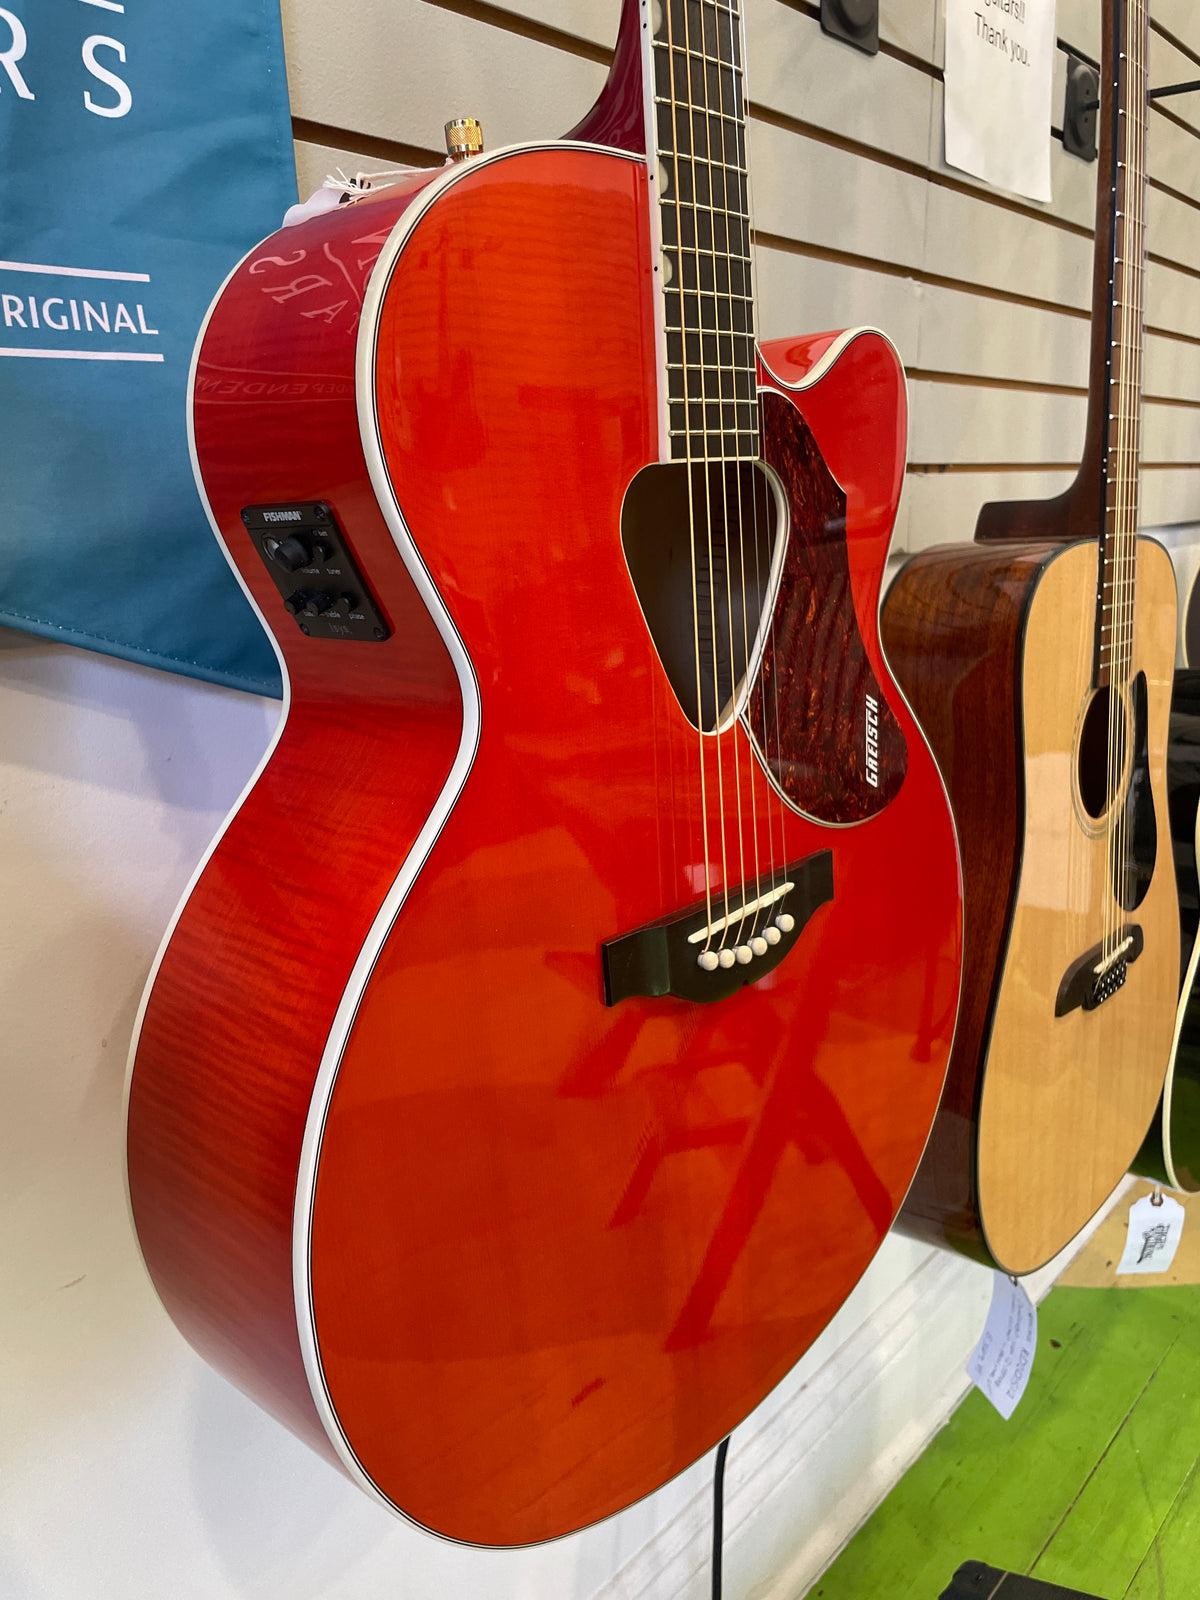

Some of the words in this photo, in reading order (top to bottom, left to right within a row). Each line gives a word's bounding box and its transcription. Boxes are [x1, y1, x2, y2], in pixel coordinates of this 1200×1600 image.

[975, 11, 1008, 54] Thank
[1010, 40, 1031, 67] you.
[263, 510, 301, 522] FISHMAN
[865, 694, 878, 788] GRETSCH
